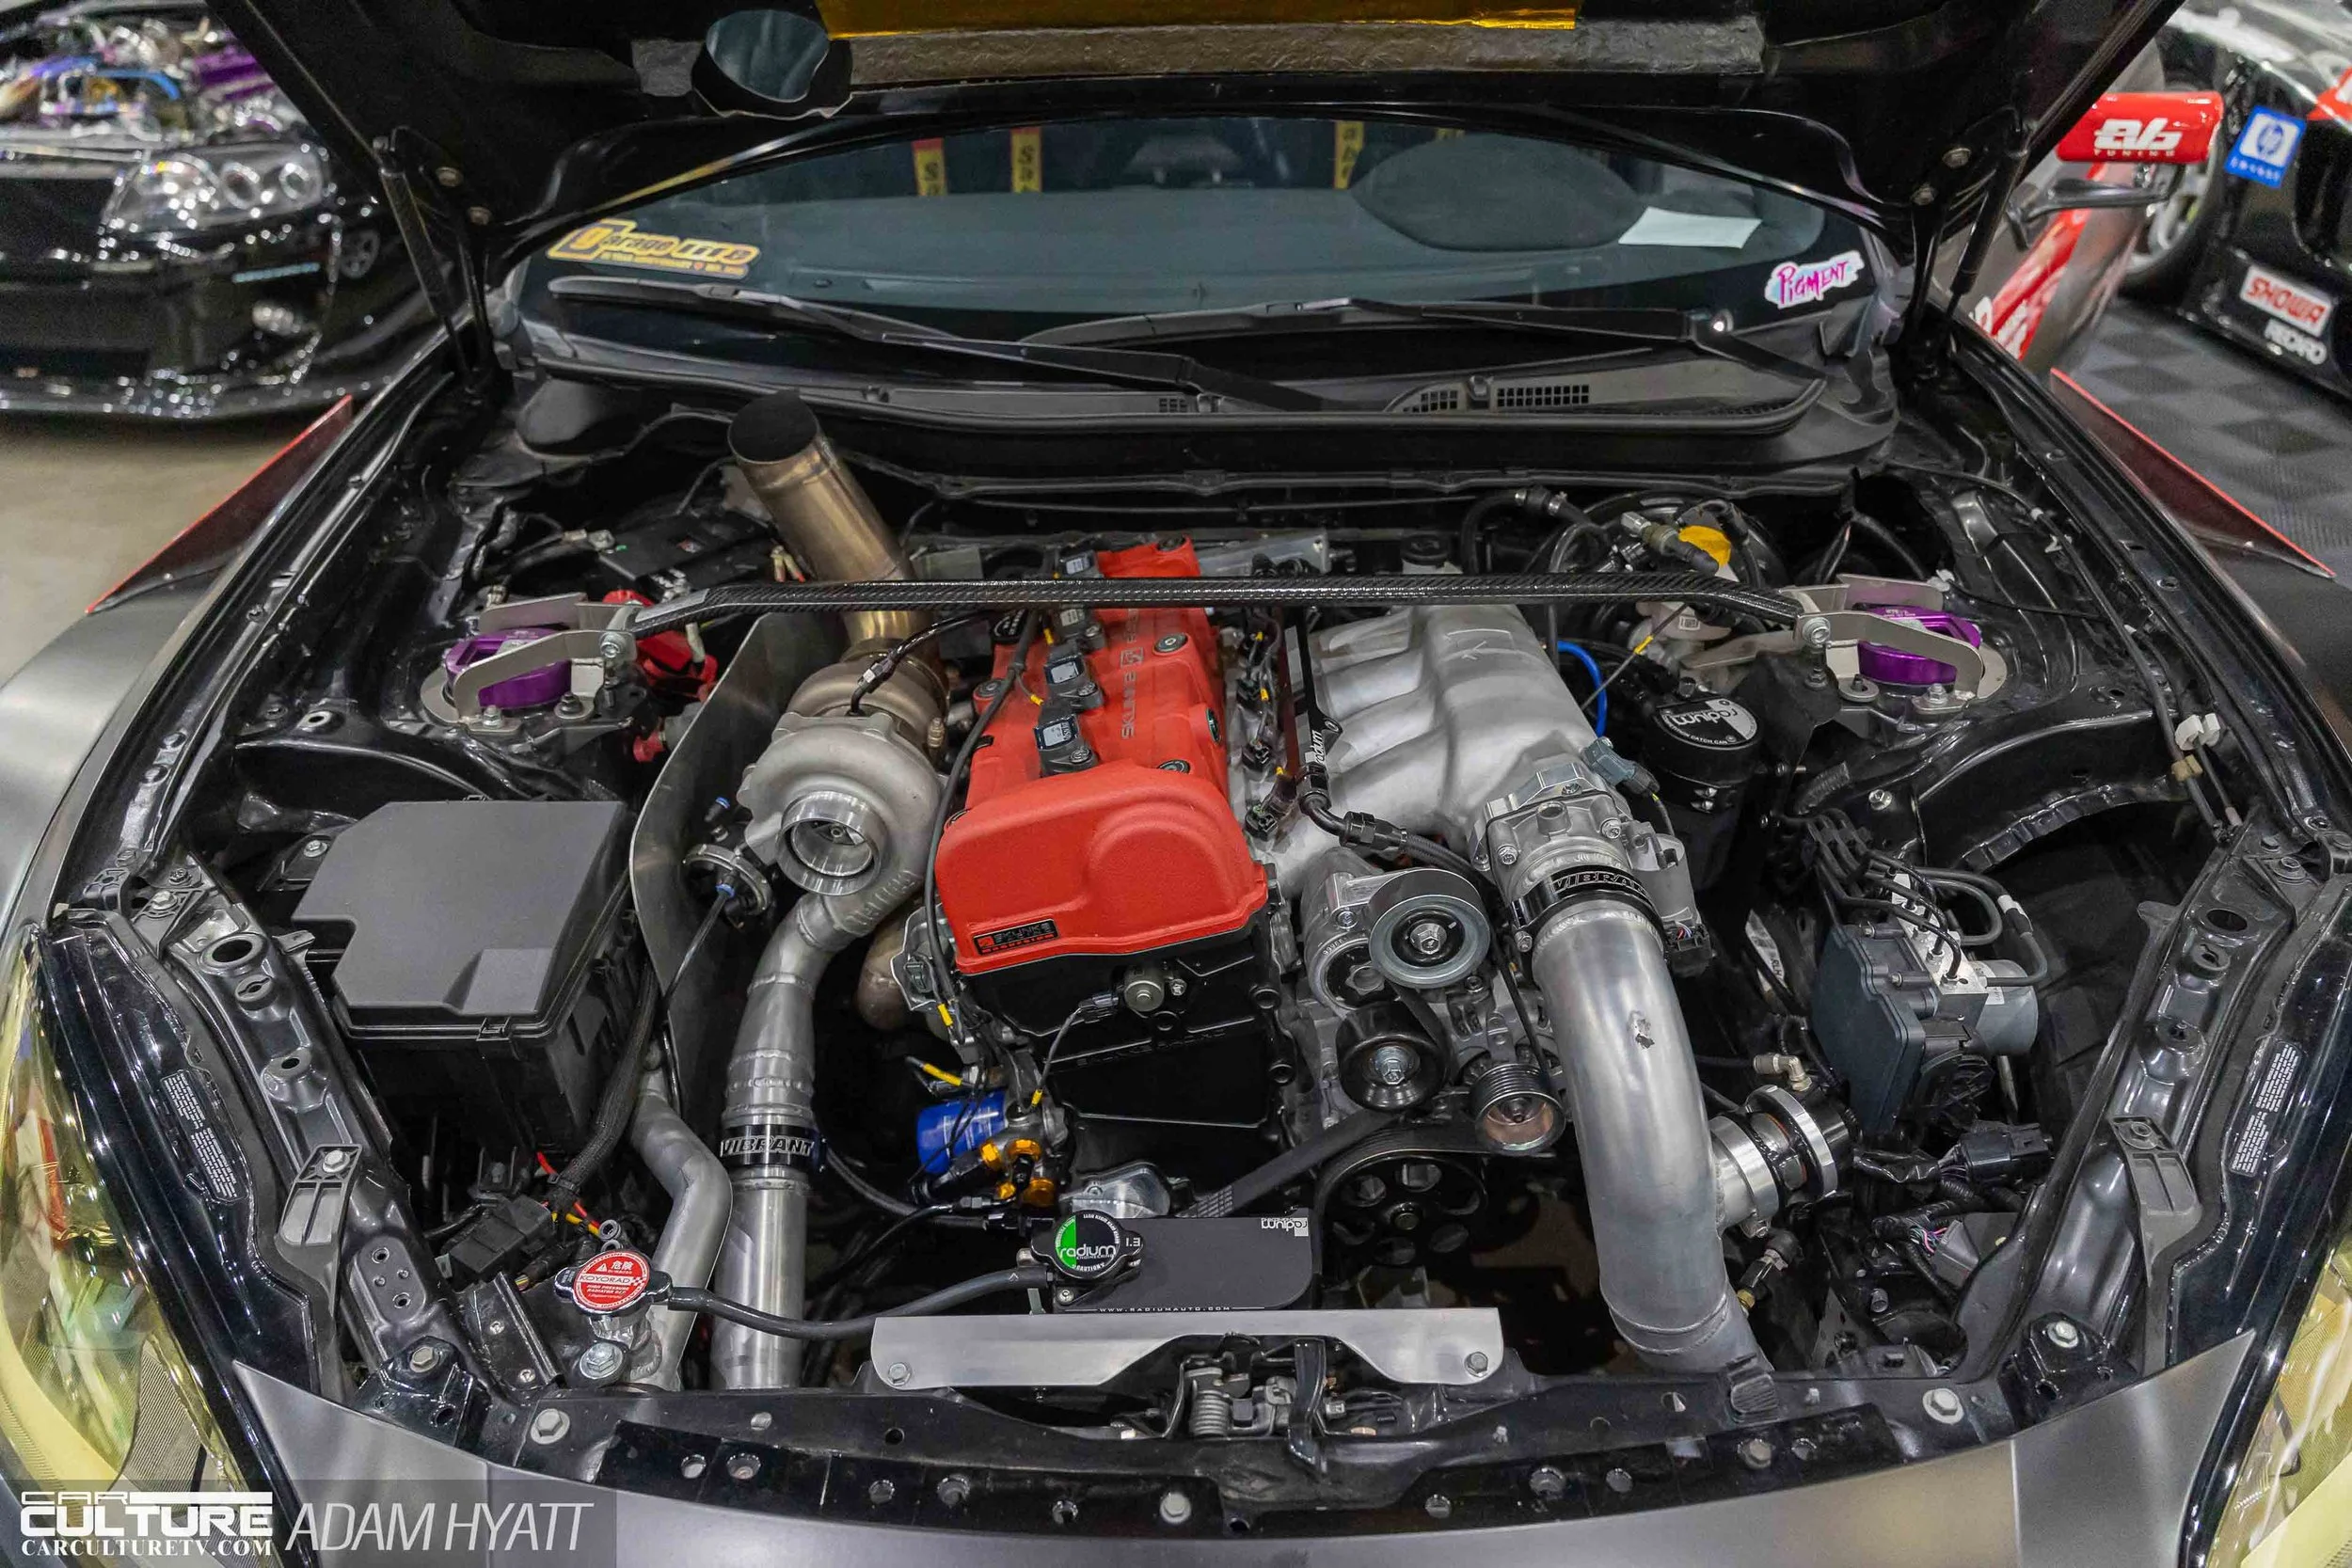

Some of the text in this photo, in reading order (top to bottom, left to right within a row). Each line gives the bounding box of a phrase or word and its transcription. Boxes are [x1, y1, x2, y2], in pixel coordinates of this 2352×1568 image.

[720, 1134, 815, 1158] VIBRANT
[1060, 1243, 1116, 1259] radium
[580, 1275, 631, 1285] KOYORAD
